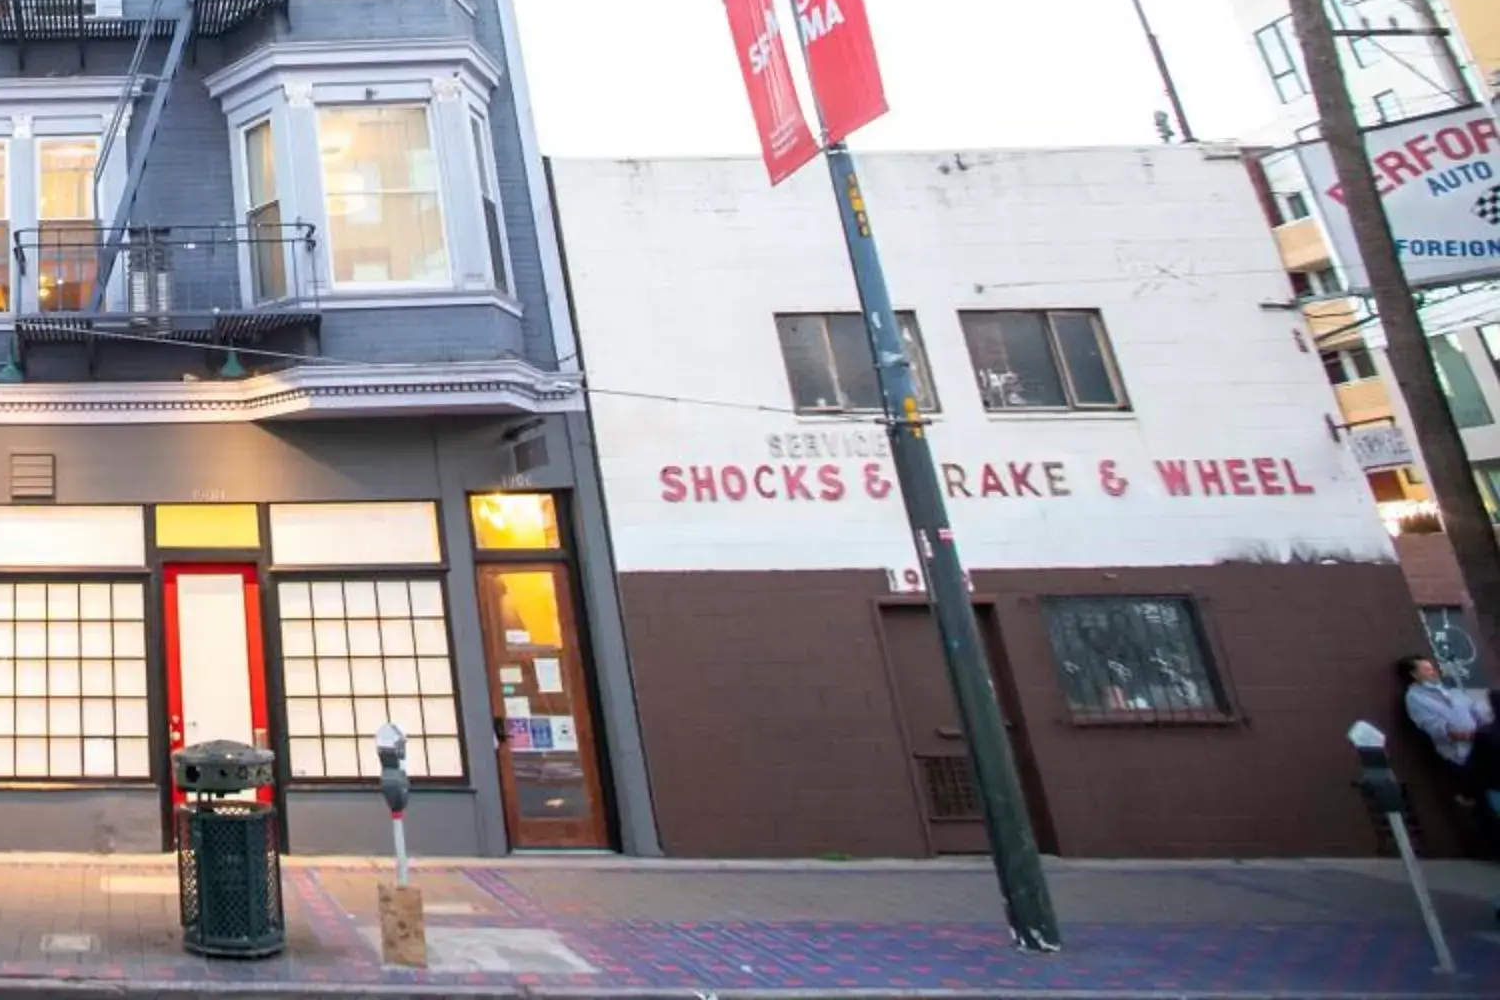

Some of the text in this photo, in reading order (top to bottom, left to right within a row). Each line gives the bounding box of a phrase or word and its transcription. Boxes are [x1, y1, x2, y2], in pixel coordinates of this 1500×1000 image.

[1425, 160, 1493, 197] AUTO
[768, 432, 890, 459] SERVICE
[660, 456, 1316, 502] SHOCKS & RAKE & WHEEL
